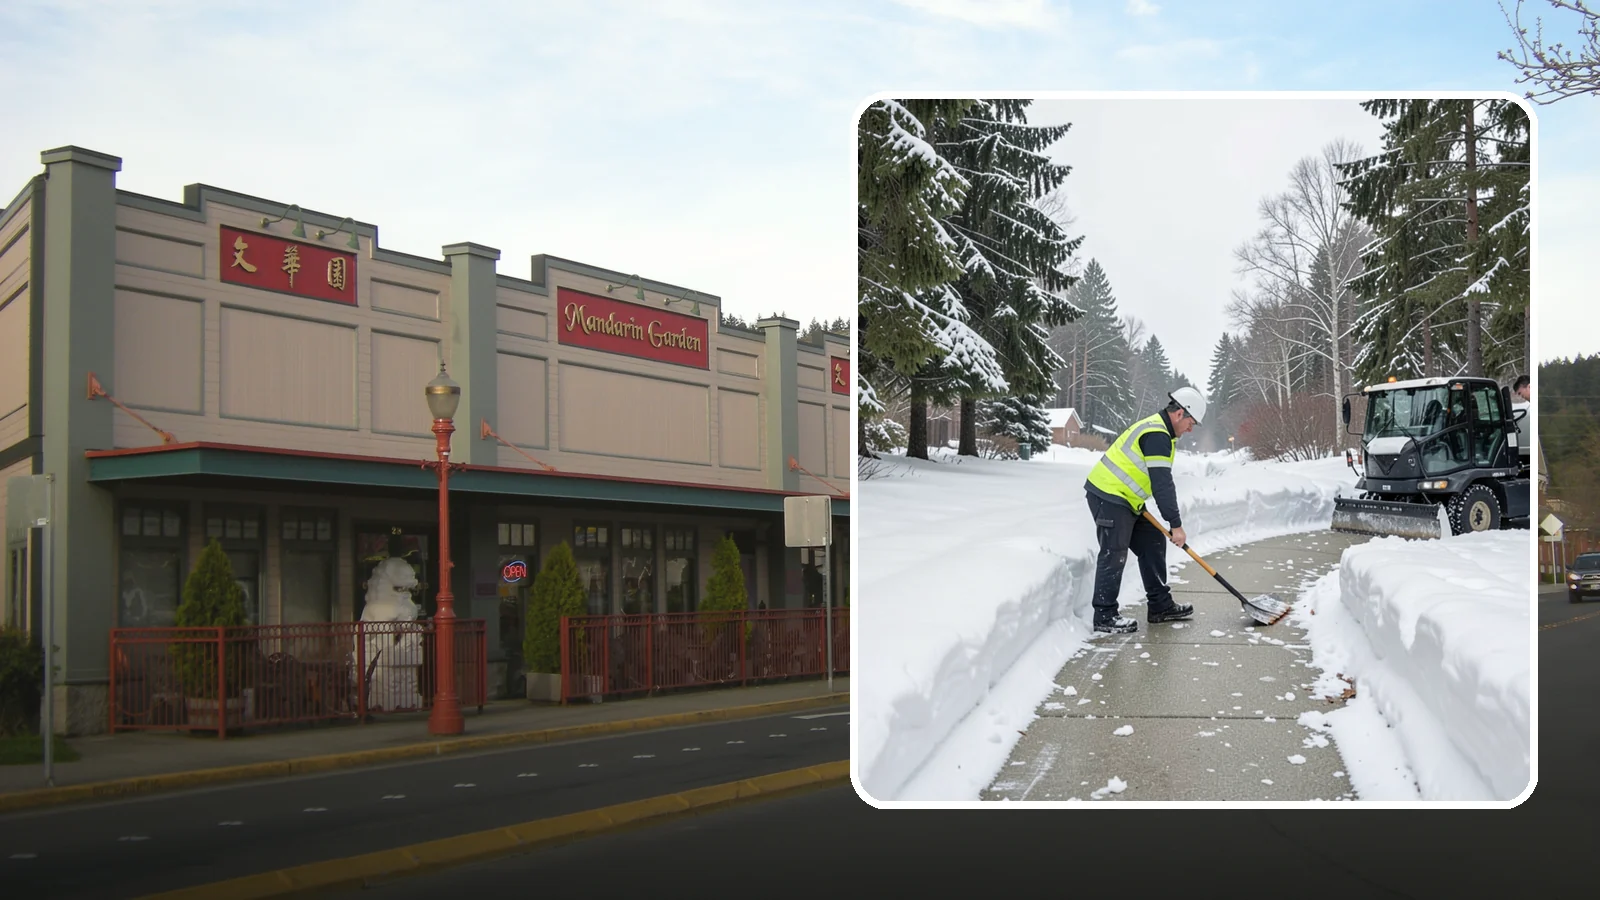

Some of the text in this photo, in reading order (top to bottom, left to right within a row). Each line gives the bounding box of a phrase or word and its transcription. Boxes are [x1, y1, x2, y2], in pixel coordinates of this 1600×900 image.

[230, 235, 346, 290] 文華園
[564, 302, 701, 352] Mandarin Garden
[503, 565, 527, 578] OPEN
